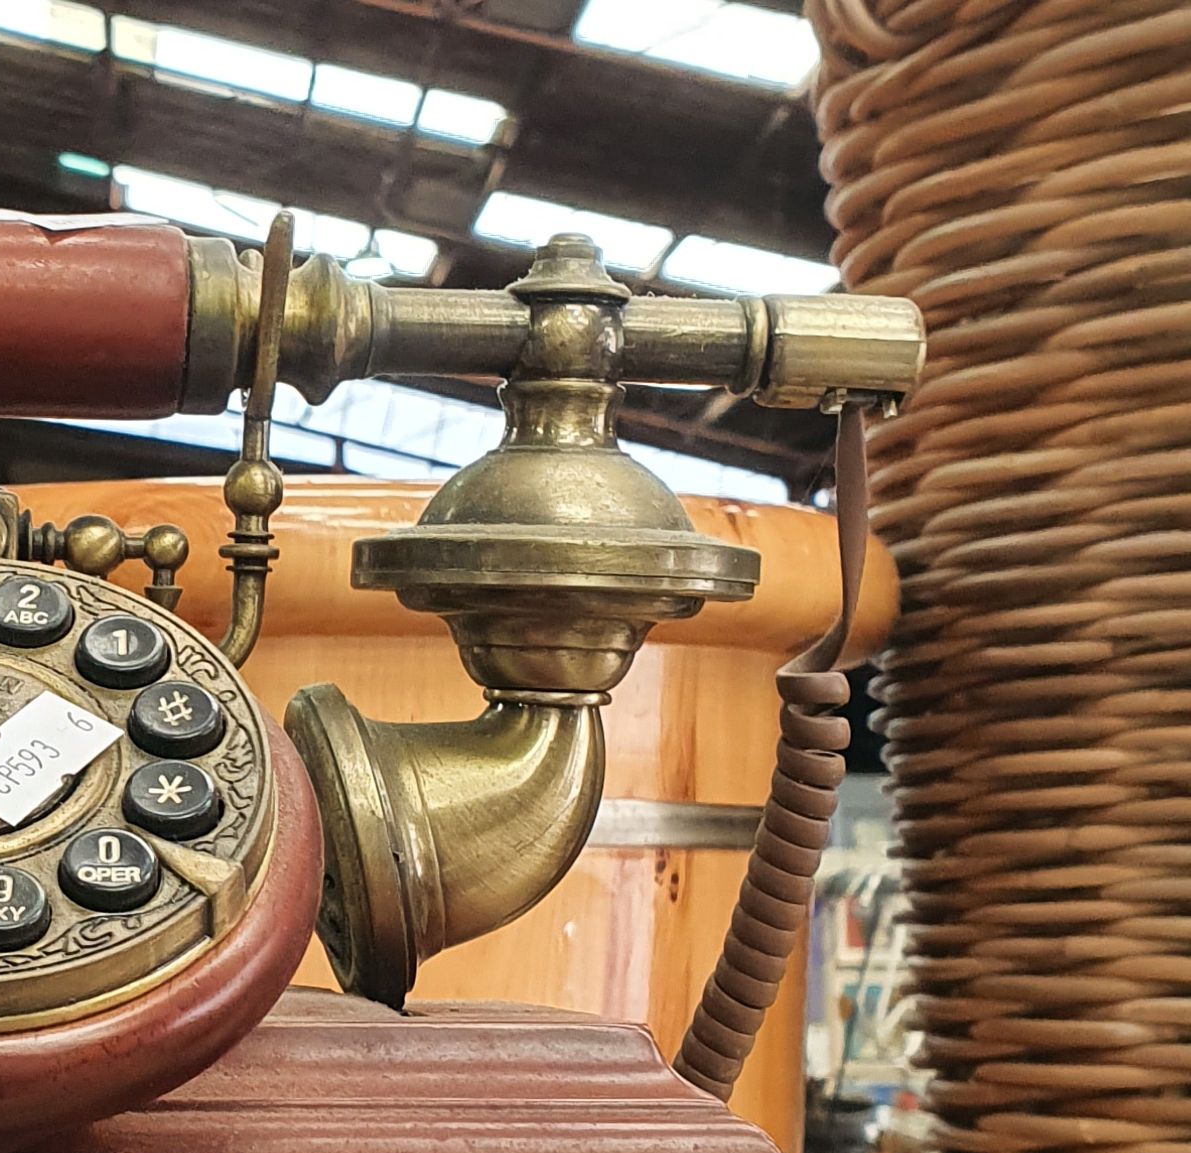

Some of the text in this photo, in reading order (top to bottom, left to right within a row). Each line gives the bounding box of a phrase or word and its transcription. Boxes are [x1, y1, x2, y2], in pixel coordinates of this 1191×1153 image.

[17, 584, 41, 609] 2
[3, 610, 49, 625] ABC
[112, 629, 128, 656] 1
[67, 711, 95, 732] 6
[98, 835, 121, 864] 0
[76, 866, 142, 883] OPER
